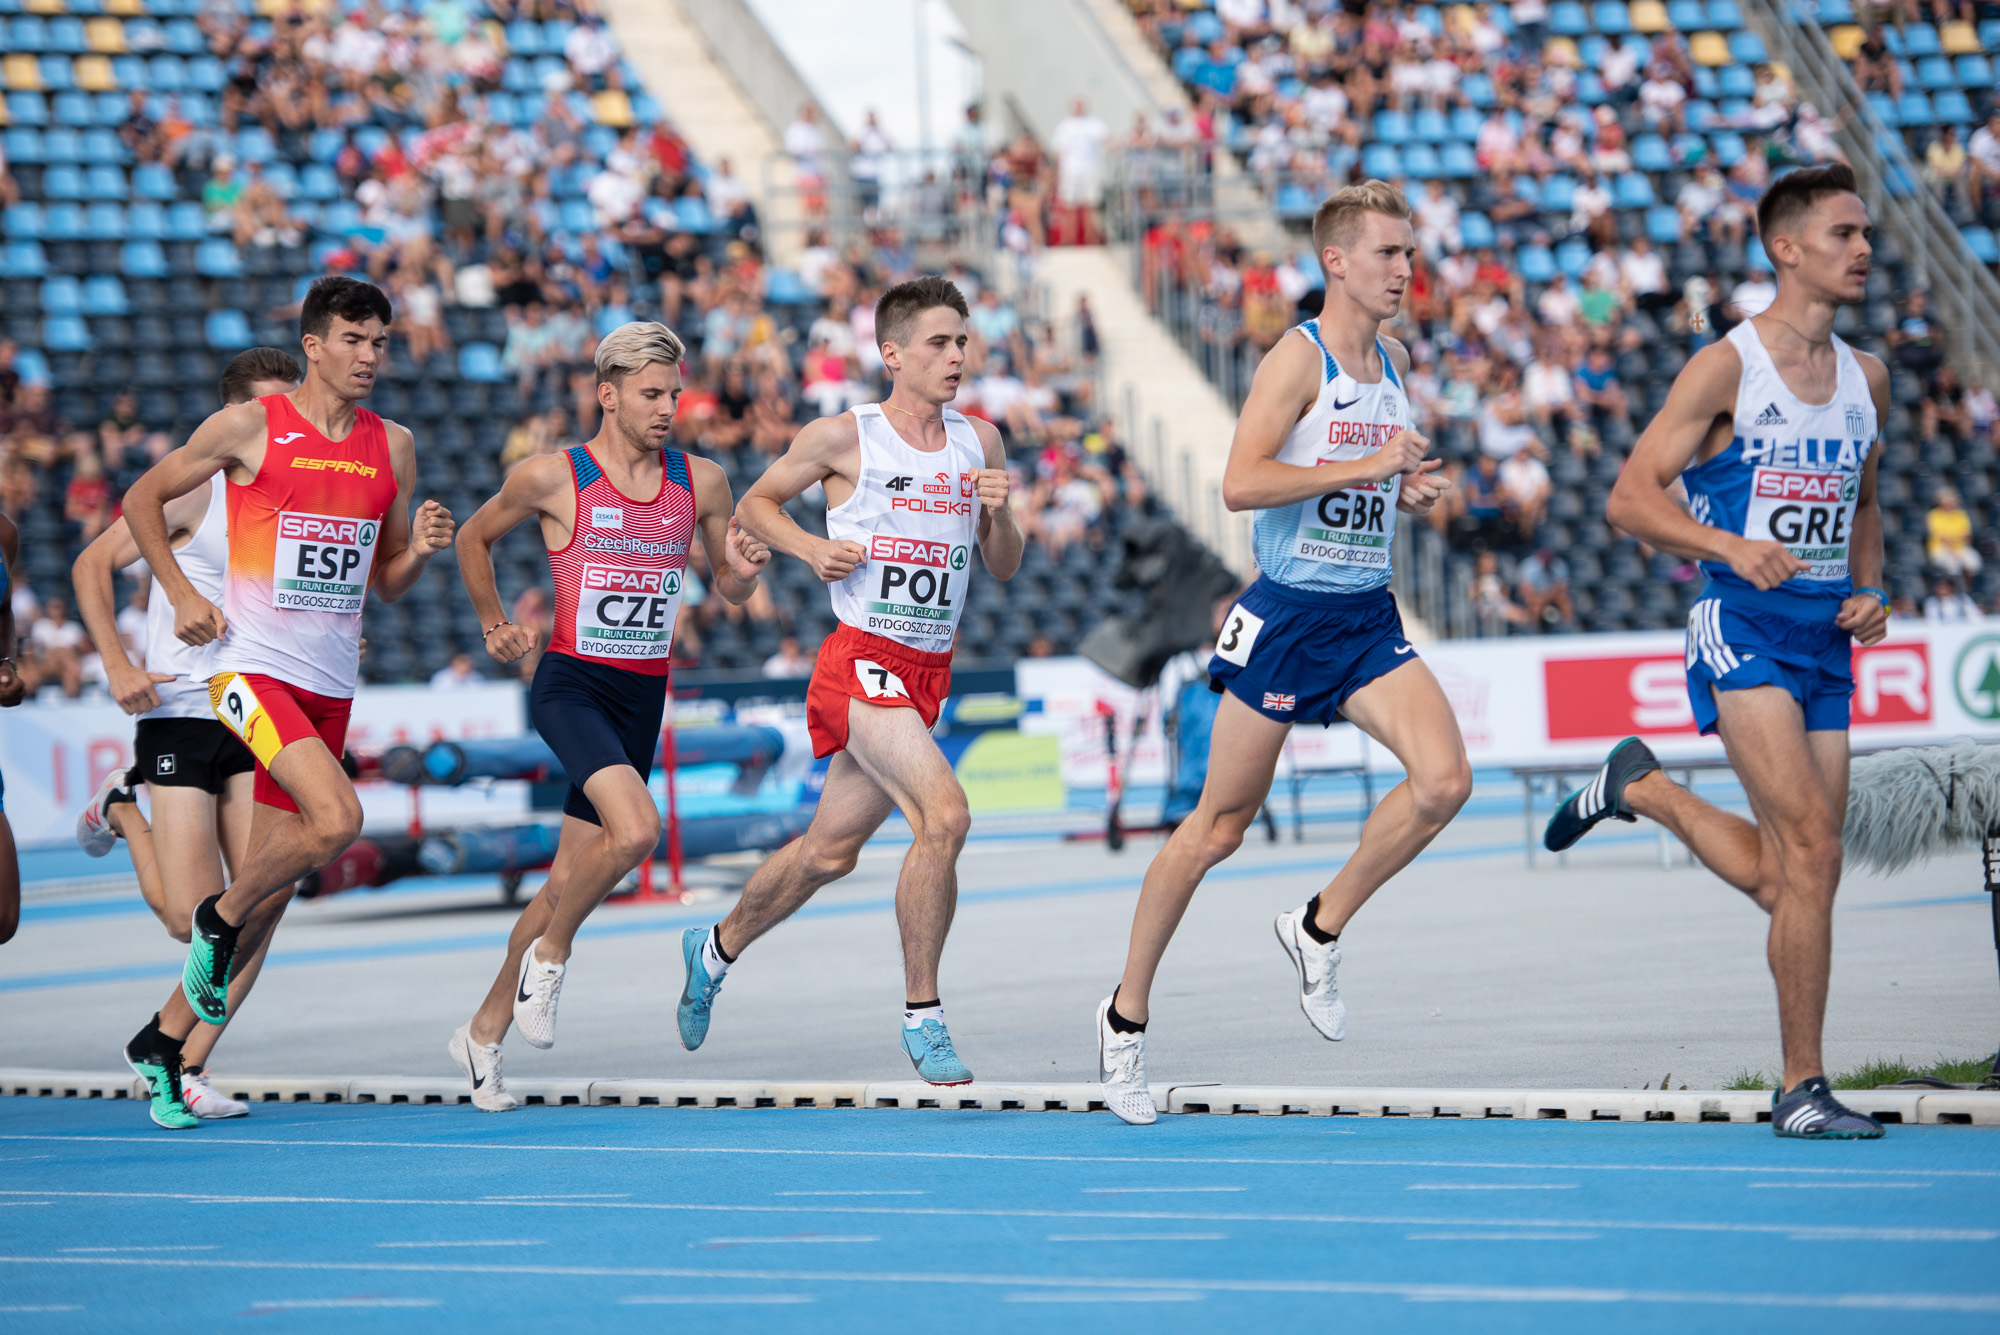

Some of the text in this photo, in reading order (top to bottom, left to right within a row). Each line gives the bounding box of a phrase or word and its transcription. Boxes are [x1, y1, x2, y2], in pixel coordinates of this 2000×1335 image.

[1755, 415, 1789, 426] adidas
[1329, 421, 1371, 447] GREAT
[290, 456, 378, 479] ESPAÑA
[885, 476, 914, 492] 4F
[924, 485, 950, 494] ORLEN
[1759, 474, 1842, 500] SPAR
[891, 497, 972, 517] POLSKA
[1317, 490, 1385, 533] GBR
[282, 518, 355, 543] SPAR
[1768, 504, 1847, 545] GRE
[584, 532, 688, 557] CzechRepublic
[1322, 530, 1327, 540] I
[1328, 531, 1350, 543] RUN
[873, 537, 947, 565] SPAR
[1369, 551, 1387, 564] 2019
[1805, 547, 1834, 559] CLEAN
[296, 543, 361, 582] ESP
[301, 581, 322, 591] RUN
[323, 583, 351, 594] CLEAN
[586, 568, 660, 591] SPAR
[880, 565, 952, 607] POL
[278, 593, 361, 610] BYDGOSZCZ 2019
[596, 594, 668, 629] CZE
[886, 604, 942, 618] I RUN CLEAN
[597, 629, 655, 640] I RUN CLEAN
[868, 616, 951, 636] BYDGOSZCZ 2019
[1221, 616, 1244, 652] 3
[581, 640, 668, 656] BYDGOSZCZ 2019
[868, 668, 888, 690] 7
[228, 691, 243, 723] 9
